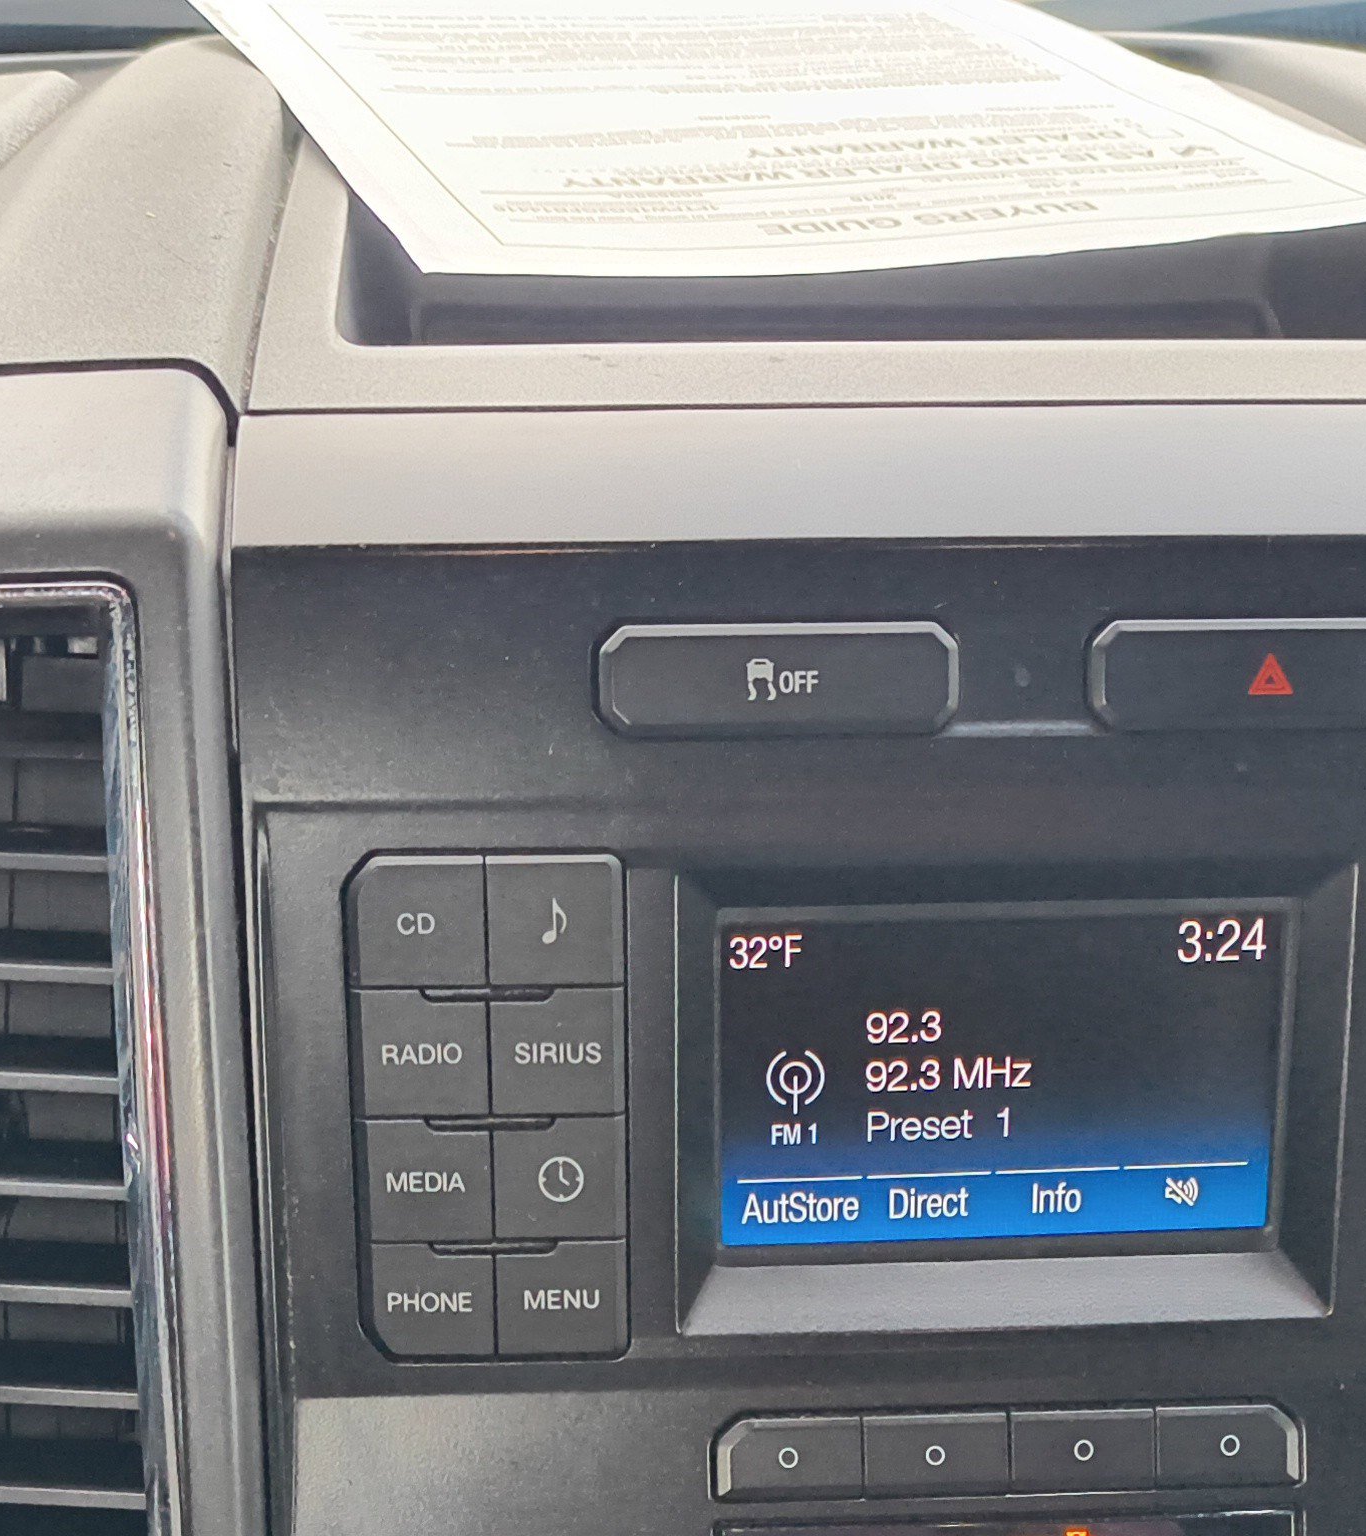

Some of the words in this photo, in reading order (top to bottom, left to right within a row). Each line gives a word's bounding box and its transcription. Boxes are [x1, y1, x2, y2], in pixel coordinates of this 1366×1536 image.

[747, 139, 965, 158] WARRANTY
[972, 130, 1125, 147] DEALER
[975, 154, 1029, 169] NO
[1057, 151, 1099, 163] IS
[1103, 148, 1155, 163] AS
[562, 171, 793, 189] WARRANTY
[798, 161, 965, 179] DEALER
[912, 200, 1099, 226] BUYERS
[757, 216, 904, 236] GUIDE
[779, 671, 819, 694] OFF
[396, 912, 435, 936] CD
[729, 934, 803, 970] 32°F
[1176, 918, 1267, 964] 3:24
[865, 1010, 943, 1045] 92.3
[381, 1042, 463, 1066] RADIO
[514, 1041, 602, 1065] SIRIUS
[865, 1060, 941, 1093] 92.3
[952, 1056, 1032, 1091] MHz
[771, 1125, 802, 1146] FM
[808, 1124, 818, 1145] 1
[867, 1109, 974, 1142] Preset
[996, 1107, 1012, 1138] 1
[386, 1170, 466, 1194] MEDIA
[741, 1192, 860, 1225] AutStore
[888, 1187, 969, 1219] Direct
[1031, 1182, 1082, 1214] Info
[387, 1291, 473, 1313] PHONE
[523, 1289, 601, 1311] MENU
